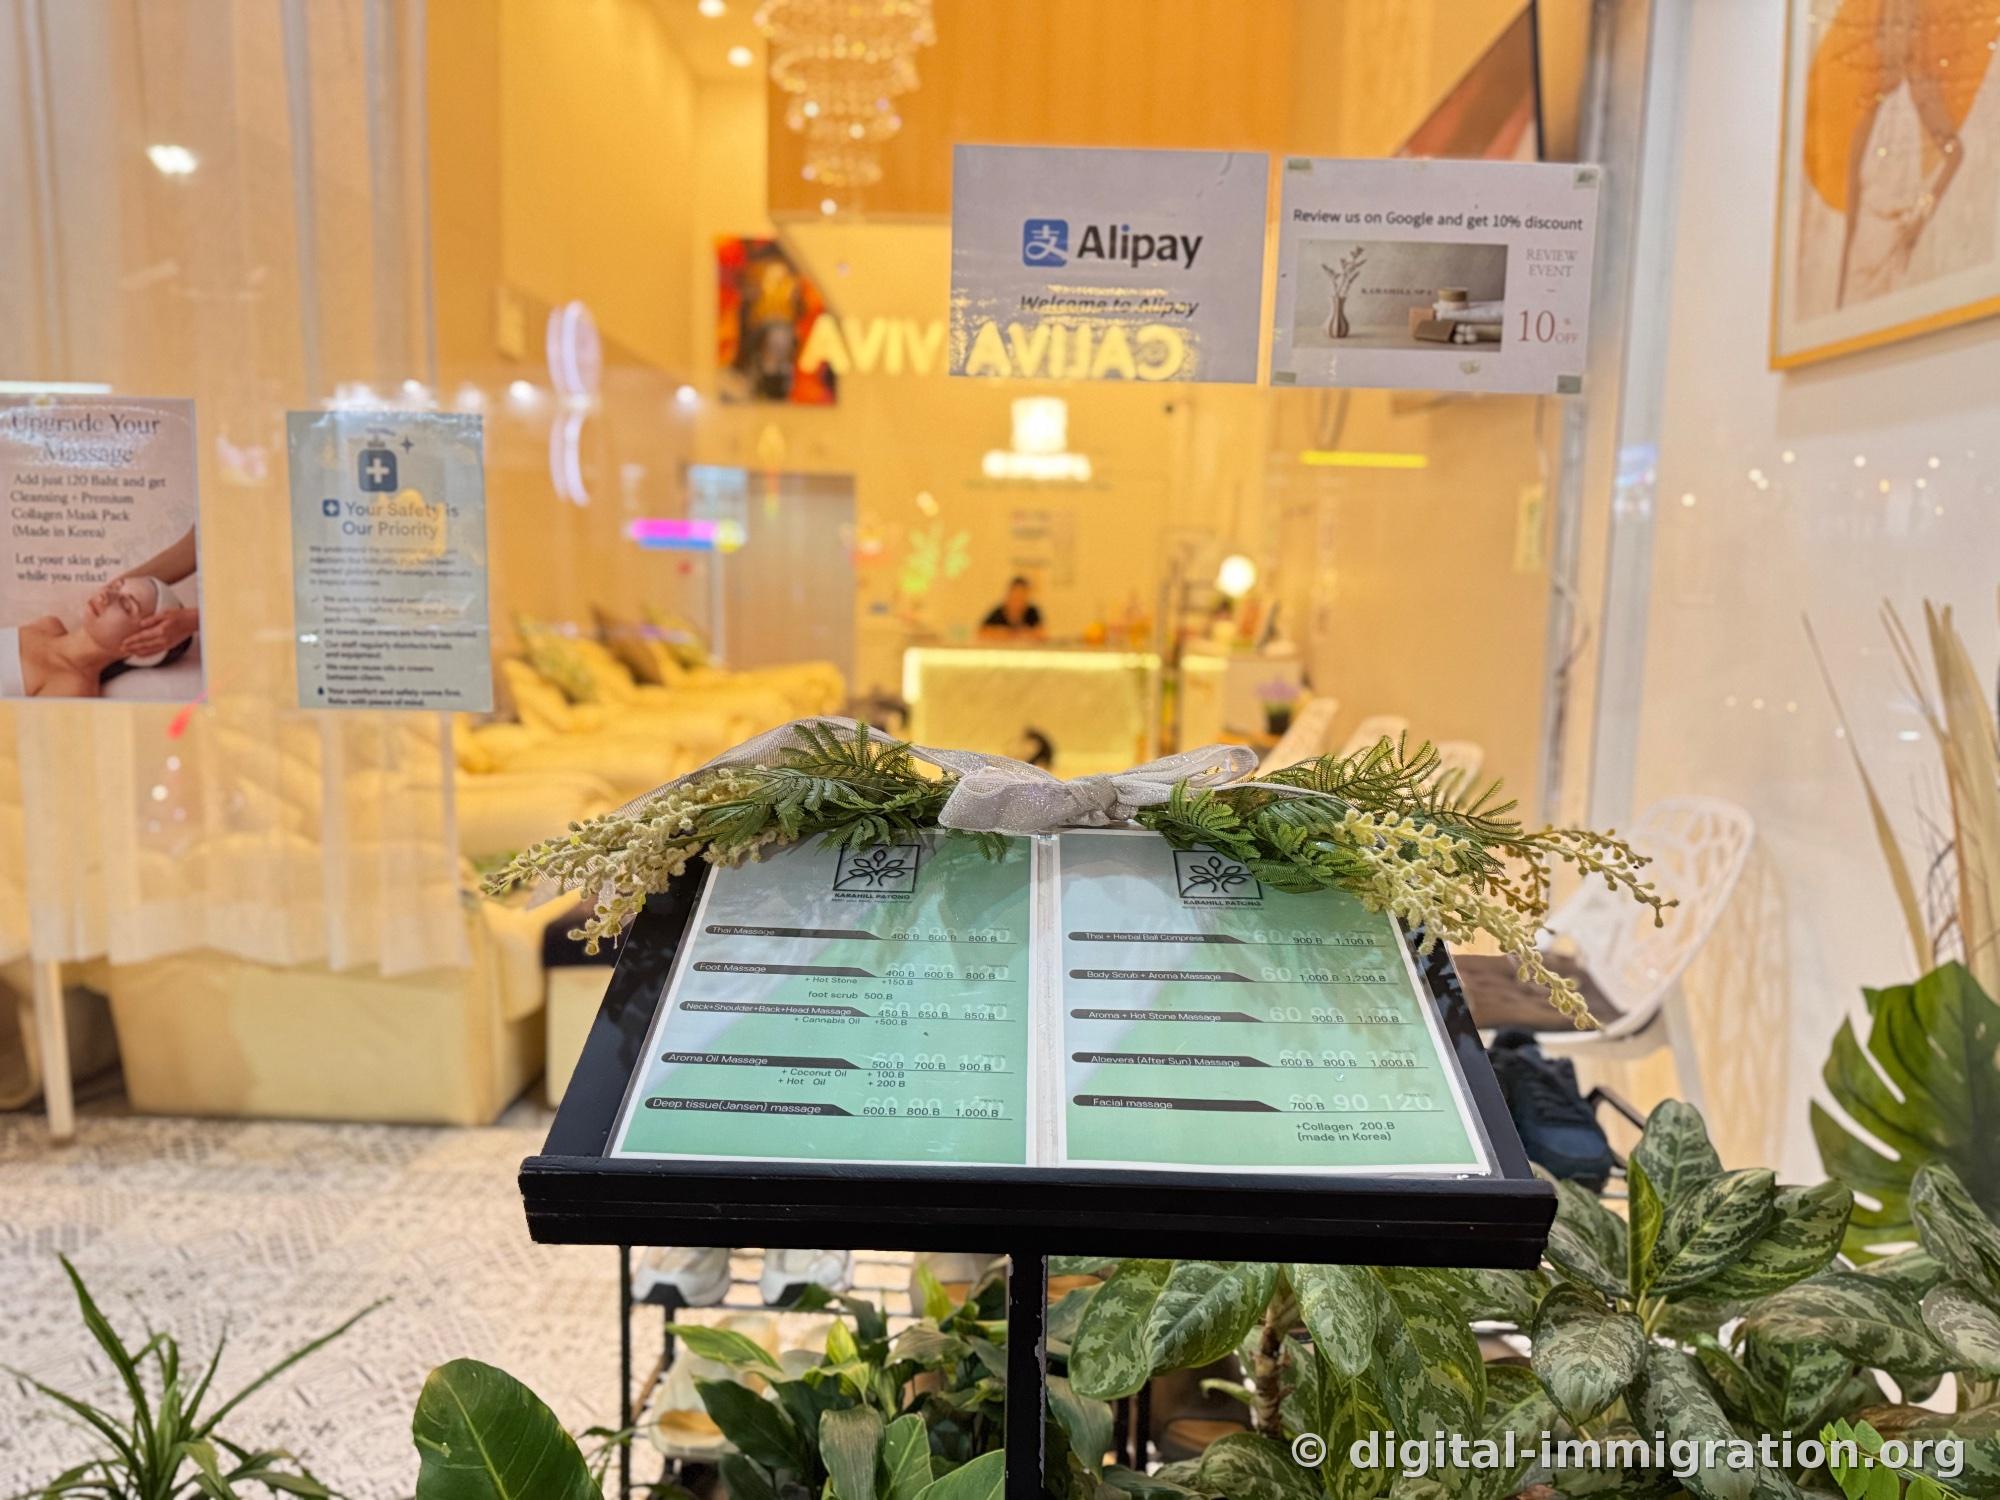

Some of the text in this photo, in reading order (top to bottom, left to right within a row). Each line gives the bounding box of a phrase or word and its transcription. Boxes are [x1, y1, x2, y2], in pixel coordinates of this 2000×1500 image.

[1293, 208, 1583, 231] Review us on Google and get 10% discount
[1077, 224, 1204, 270] Alipay
[1526, 248, 1578, 262] REVIEW
[1528, 264, 1574, 277] EVENT
[1020, 296, 1200, 318] Welcome to Alipay
[1518, 309, 1556, 343] 10
[1555, 333, 1579, 344] OFF
[12, 412, 161, 439] Upgrade Your
[43, 441, 134, 468] Massage
[15, 474, 166, 490] Add just 120 Baht and get
[10, 491, 68, 505] Cleansing
[81, 492, 135, 504] Premium
[11, 508, 130, 522] Collagen Mask Pack
[345, 501, 459, 522] Your Safety is
[12, 525, 107, 539] (Made in Korea)
[342, 521, 439, 541] Our Priority
[15, 553, 122, 568] Let your skin glow
[17, 570, 107, 585] while you relax!
[712, 926, 775, 937] Thai Massage
[1085, 932, 1104, 940] Thai
[1113, 933, 1141, 941] Herbal
[1160, 934, 1205, 943] Compress
[700, 963, 767, 974] Foot Massage
[832, 977, 858, 985] Stone
[1086, 971, 1110, 979] Body
[1112, 971, 1139, 979] Scrub
[1149, 972, 1179, 980] Aroma
[1180, 973, 1222, 982] Massage
[808, 990, 893, 1000] foot scrub 500.B
[686, 1002, 851, 1018] Neck+Shoulder+Back+Head Massage
[802, 1016, 845, 1024] Cannabis
[848, 1016, 861, 1025] Oil
[1088, 1011, 1120, 1019] Aroma
[1130, 1012, 1147, 1020] Hot
[1148, 1012, 1177, 1021] Stone
[1178, 1013, 1222, 1023] Massage
[667, 1053, 768, 1066] Aroma Oil Massage
[1090, 1055, 1240, 1068] Aloevera (After Sun) Massage
[790, 1068, 832, 1077] Coconut
[834, 1069, 847, 1078] Oil
[787, 1077, 804, 1085] Hot
[813, 1078, 826, 1086] Oil
[652, 1098, 822, 1115] Deep tissue(Jansen) massage
[1092, 1097, 1173, 1110] Facial massage
[1291, 1092, 1433, 1112] 700.B 90 120
[863, 1106, 897, 1116] 600.B
[906, 1107, 940, 1116] 800.B
[1295, 1121, 1396, 1133] +Collagen 200.B
[1297, 1131, 1392, 1143] (made in Korea)
